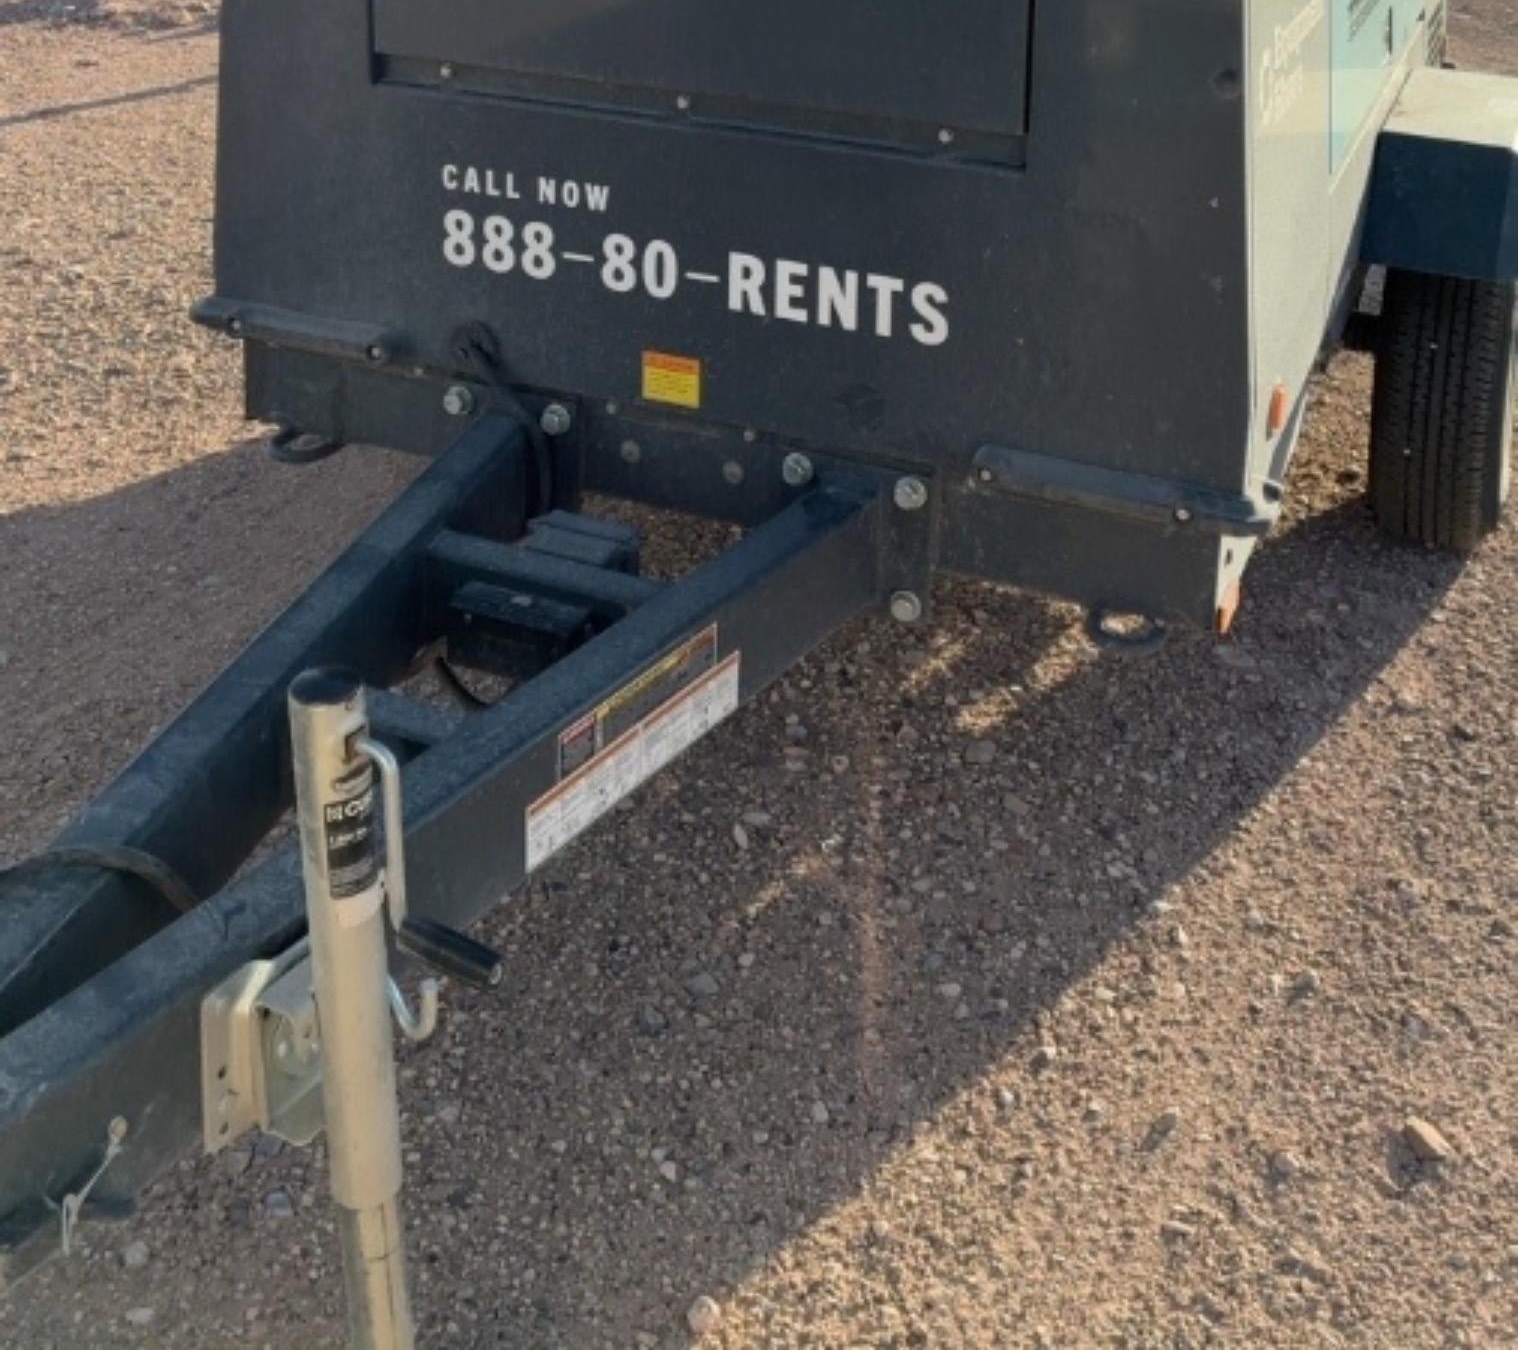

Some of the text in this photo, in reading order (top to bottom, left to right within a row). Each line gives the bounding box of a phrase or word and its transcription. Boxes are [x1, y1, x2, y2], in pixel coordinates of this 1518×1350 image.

[441, 163, 610, 212] CALL NOW
[442, 208, 950, 346] 888-80-RENTS
